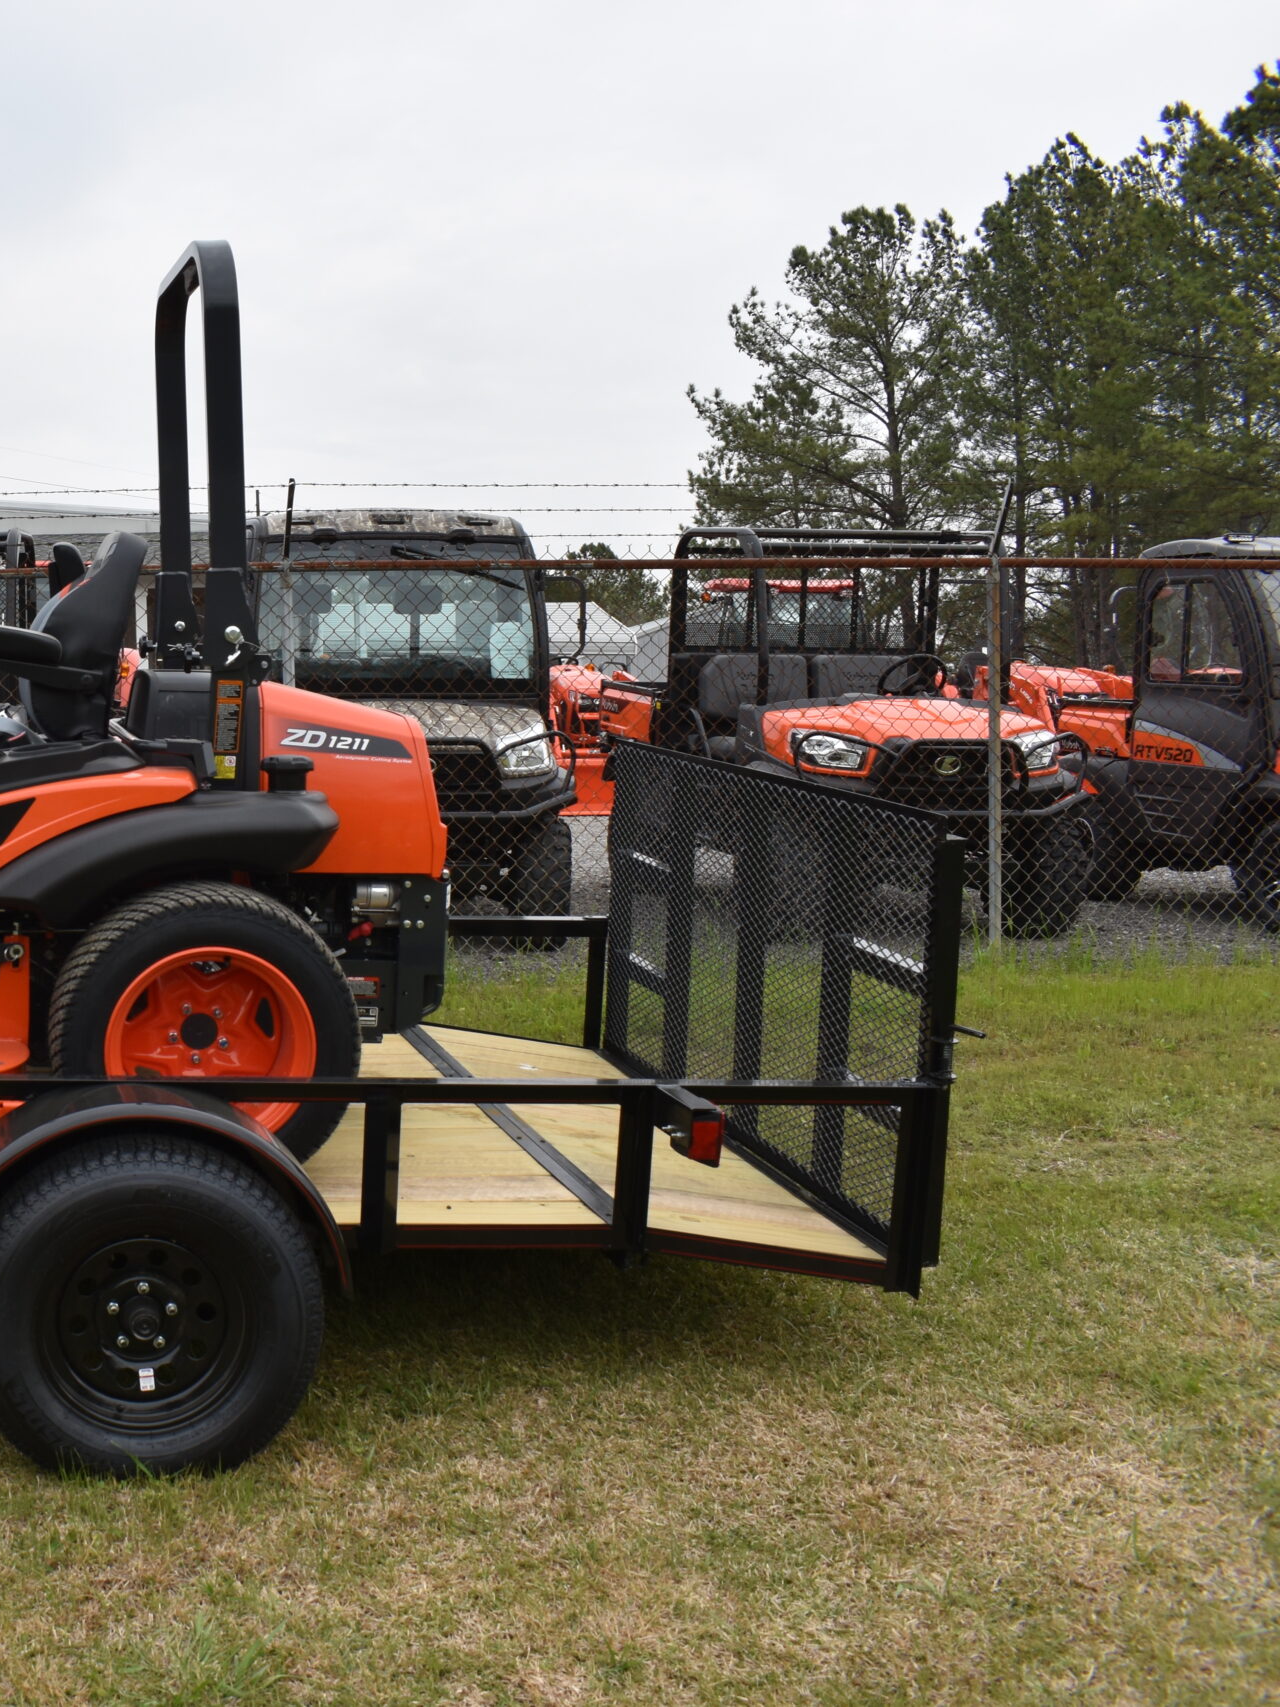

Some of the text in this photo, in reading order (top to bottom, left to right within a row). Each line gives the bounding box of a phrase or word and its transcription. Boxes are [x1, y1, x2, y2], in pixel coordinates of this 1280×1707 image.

[280, 728, 370, 751] ZD 1211
[1134, 744, 1194, 762] RTV520
